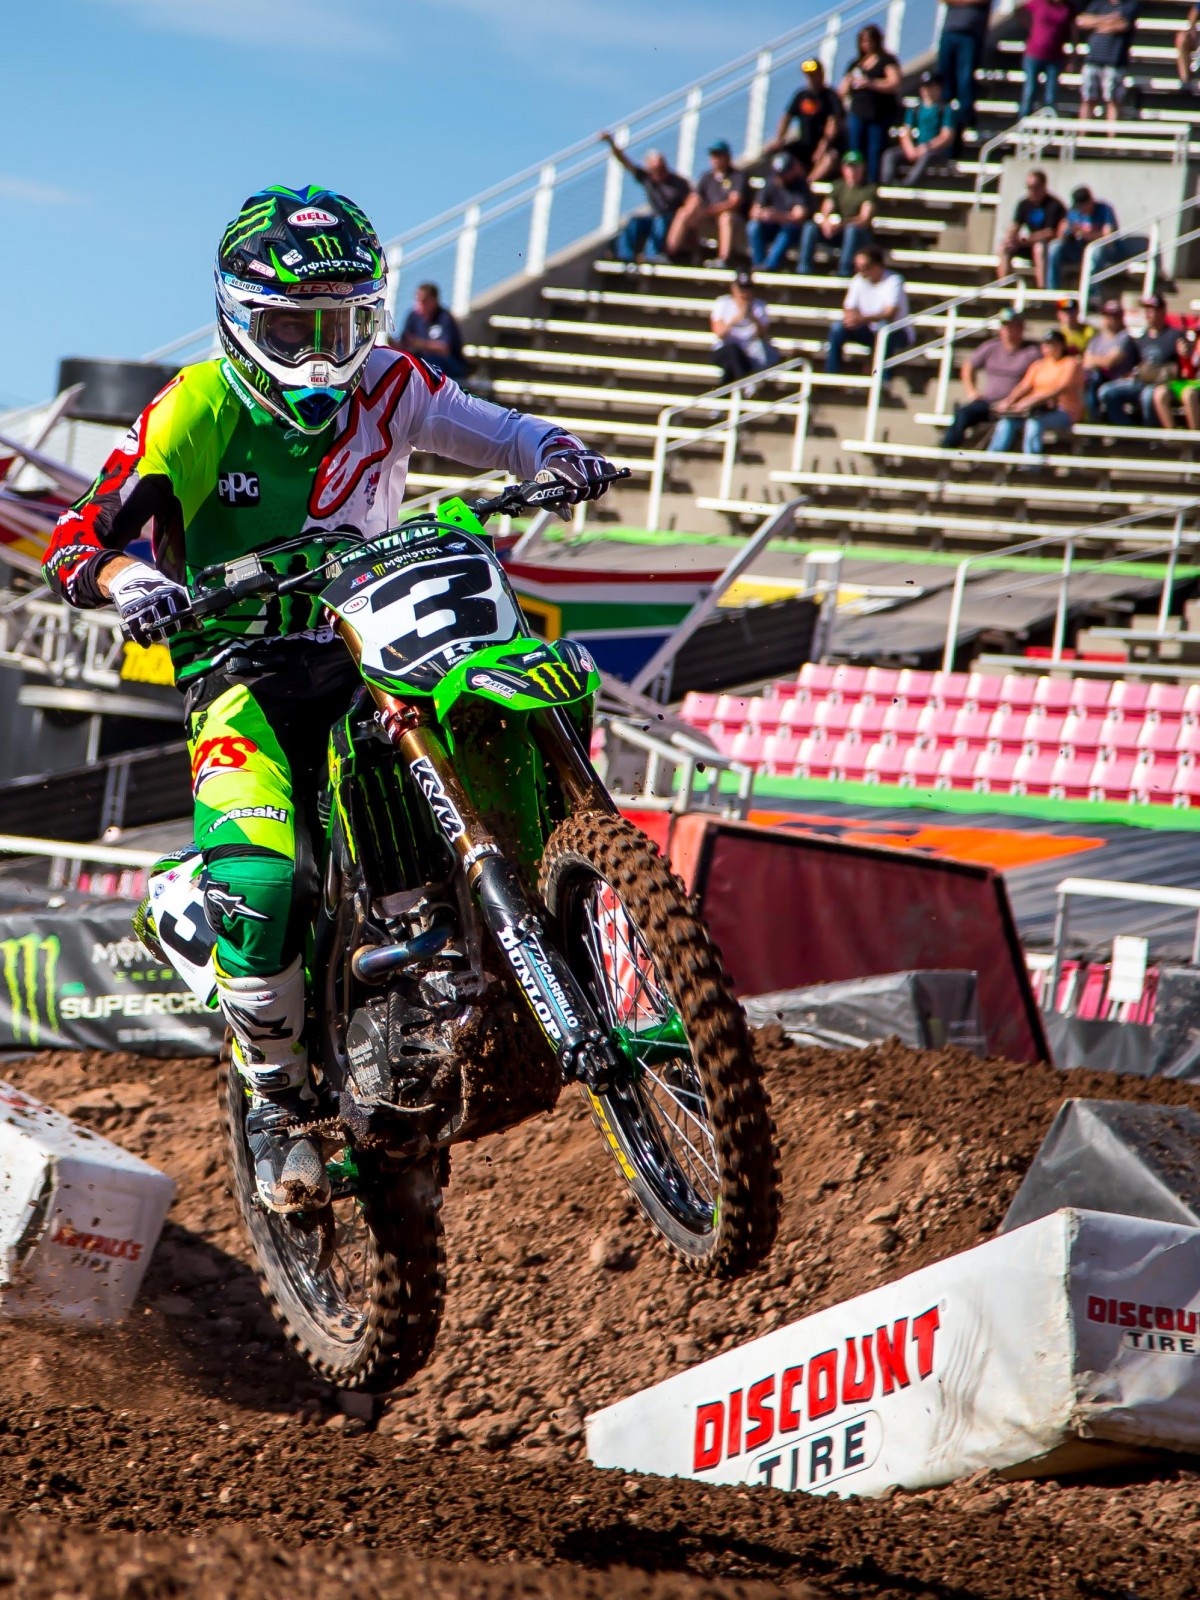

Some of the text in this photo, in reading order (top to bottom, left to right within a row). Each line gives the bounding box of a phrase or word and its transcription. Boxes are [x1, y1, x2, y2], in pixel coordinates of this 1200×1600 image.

[296, 211, 332, 222] BELL
[294, 259, 373, 275] MONSTER
[286, 282, 338, 294] FLEX
[221, 362, 255, 410] Kawasaki
[310, 376, 328, 384] BELL
[527, 486, 564, 502] ARC
[384, 546, 443, 569] MONSTER
[370, 557, 499, 672] 3
[497, 926, 562, 1040] DUNLOP
[540, 963, 579, 1028] CARRILLO
[1087, 1295, 1200, 1335] DISCOU
[1127, 1332, 1196, 1354] TIRE
[693, 1304, 940, 1474] DISCOUNT
[757, 1420, 867, 1491] TIRE
